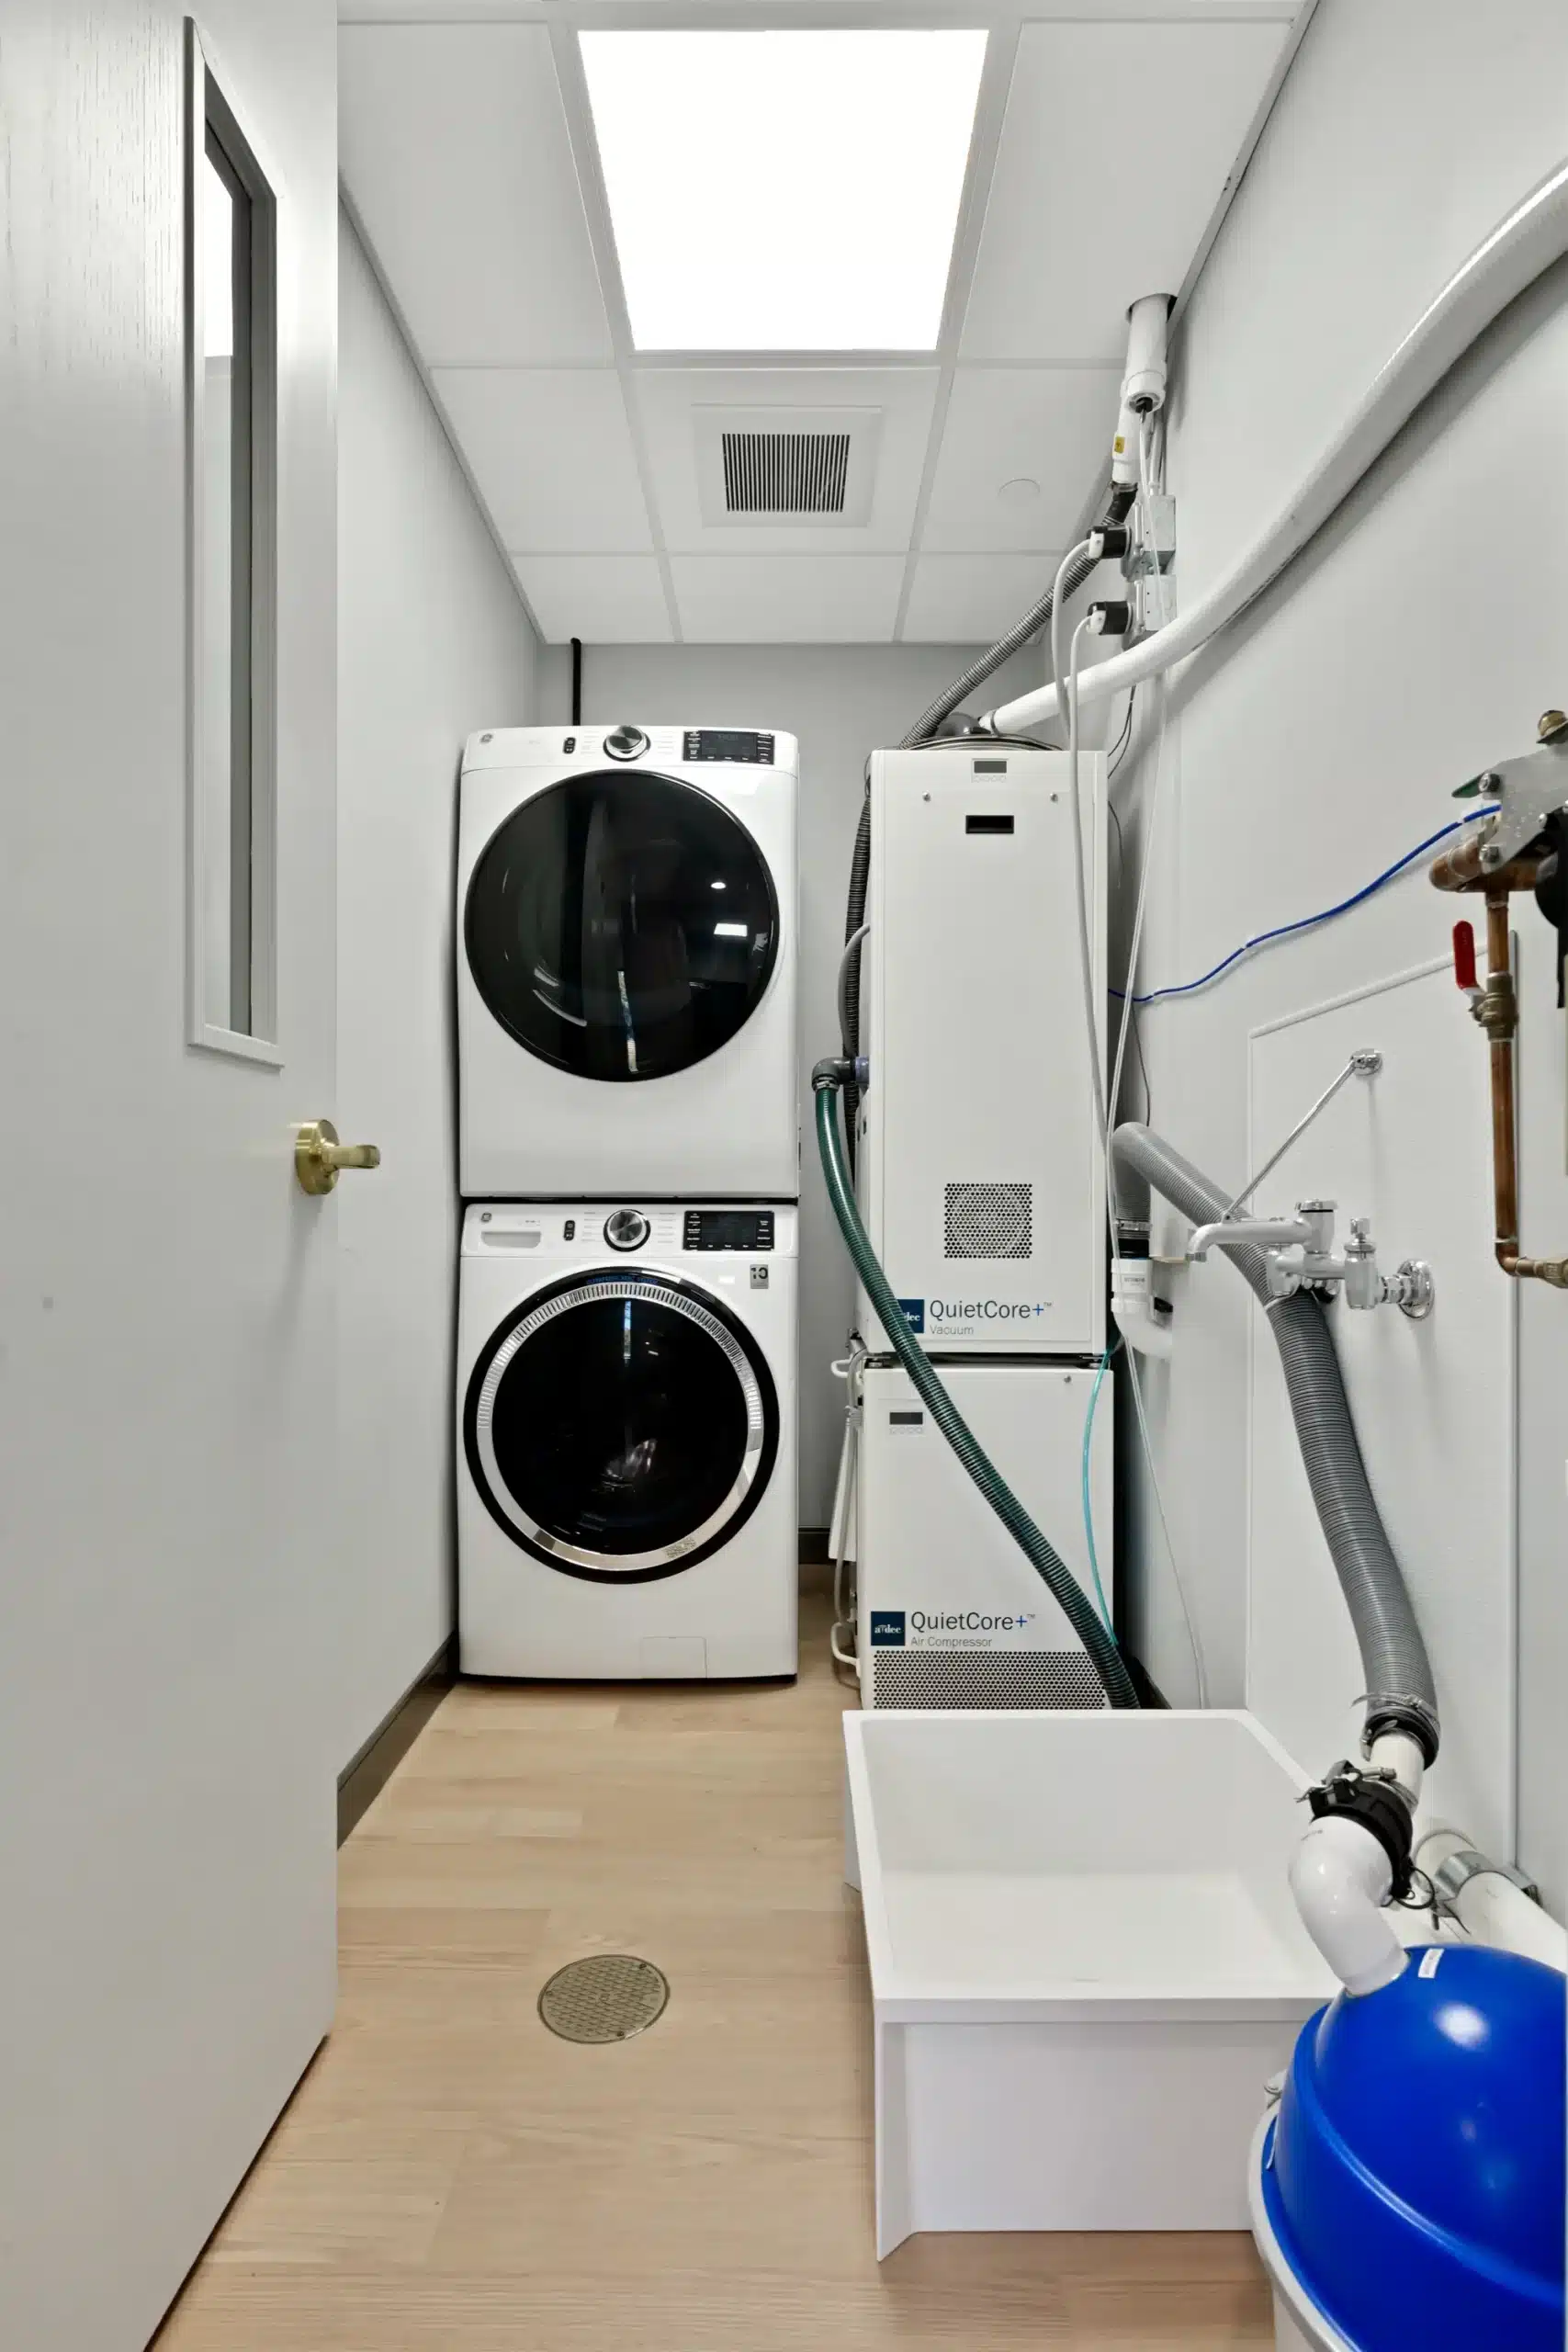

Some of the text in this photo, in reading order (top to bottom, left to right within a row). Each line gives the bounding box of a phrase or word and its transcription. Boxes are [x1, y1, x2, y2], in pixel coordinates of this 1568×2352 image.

[930, 1324, 975, 1335] Vacuum
[910, 1636, 992, 1648] Air Compressor
